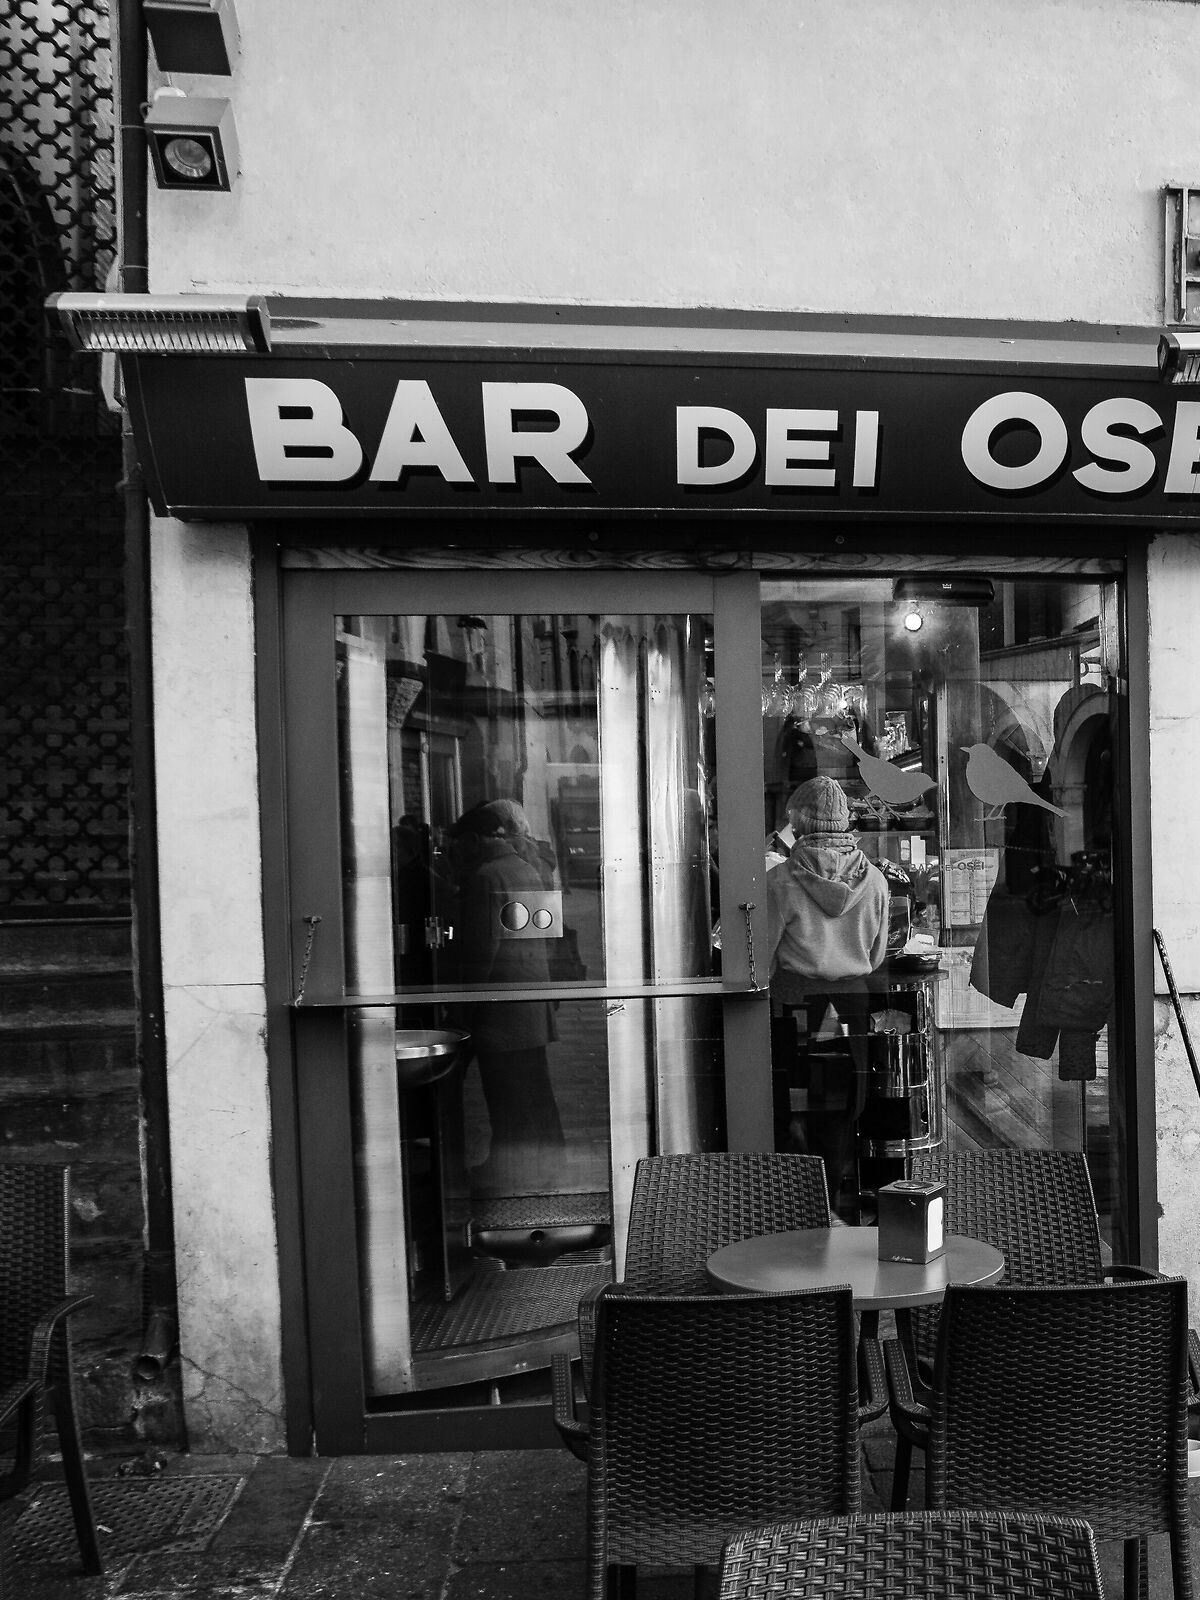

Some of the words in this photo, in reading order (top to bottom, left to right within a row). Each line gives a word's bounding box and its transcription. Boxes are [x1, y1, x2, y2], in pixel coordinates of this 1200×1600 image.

[244, 377, 593, 484] BAR
[676, 405, 880, 489] DEI
[957, 861, 985, 871] OSEI
